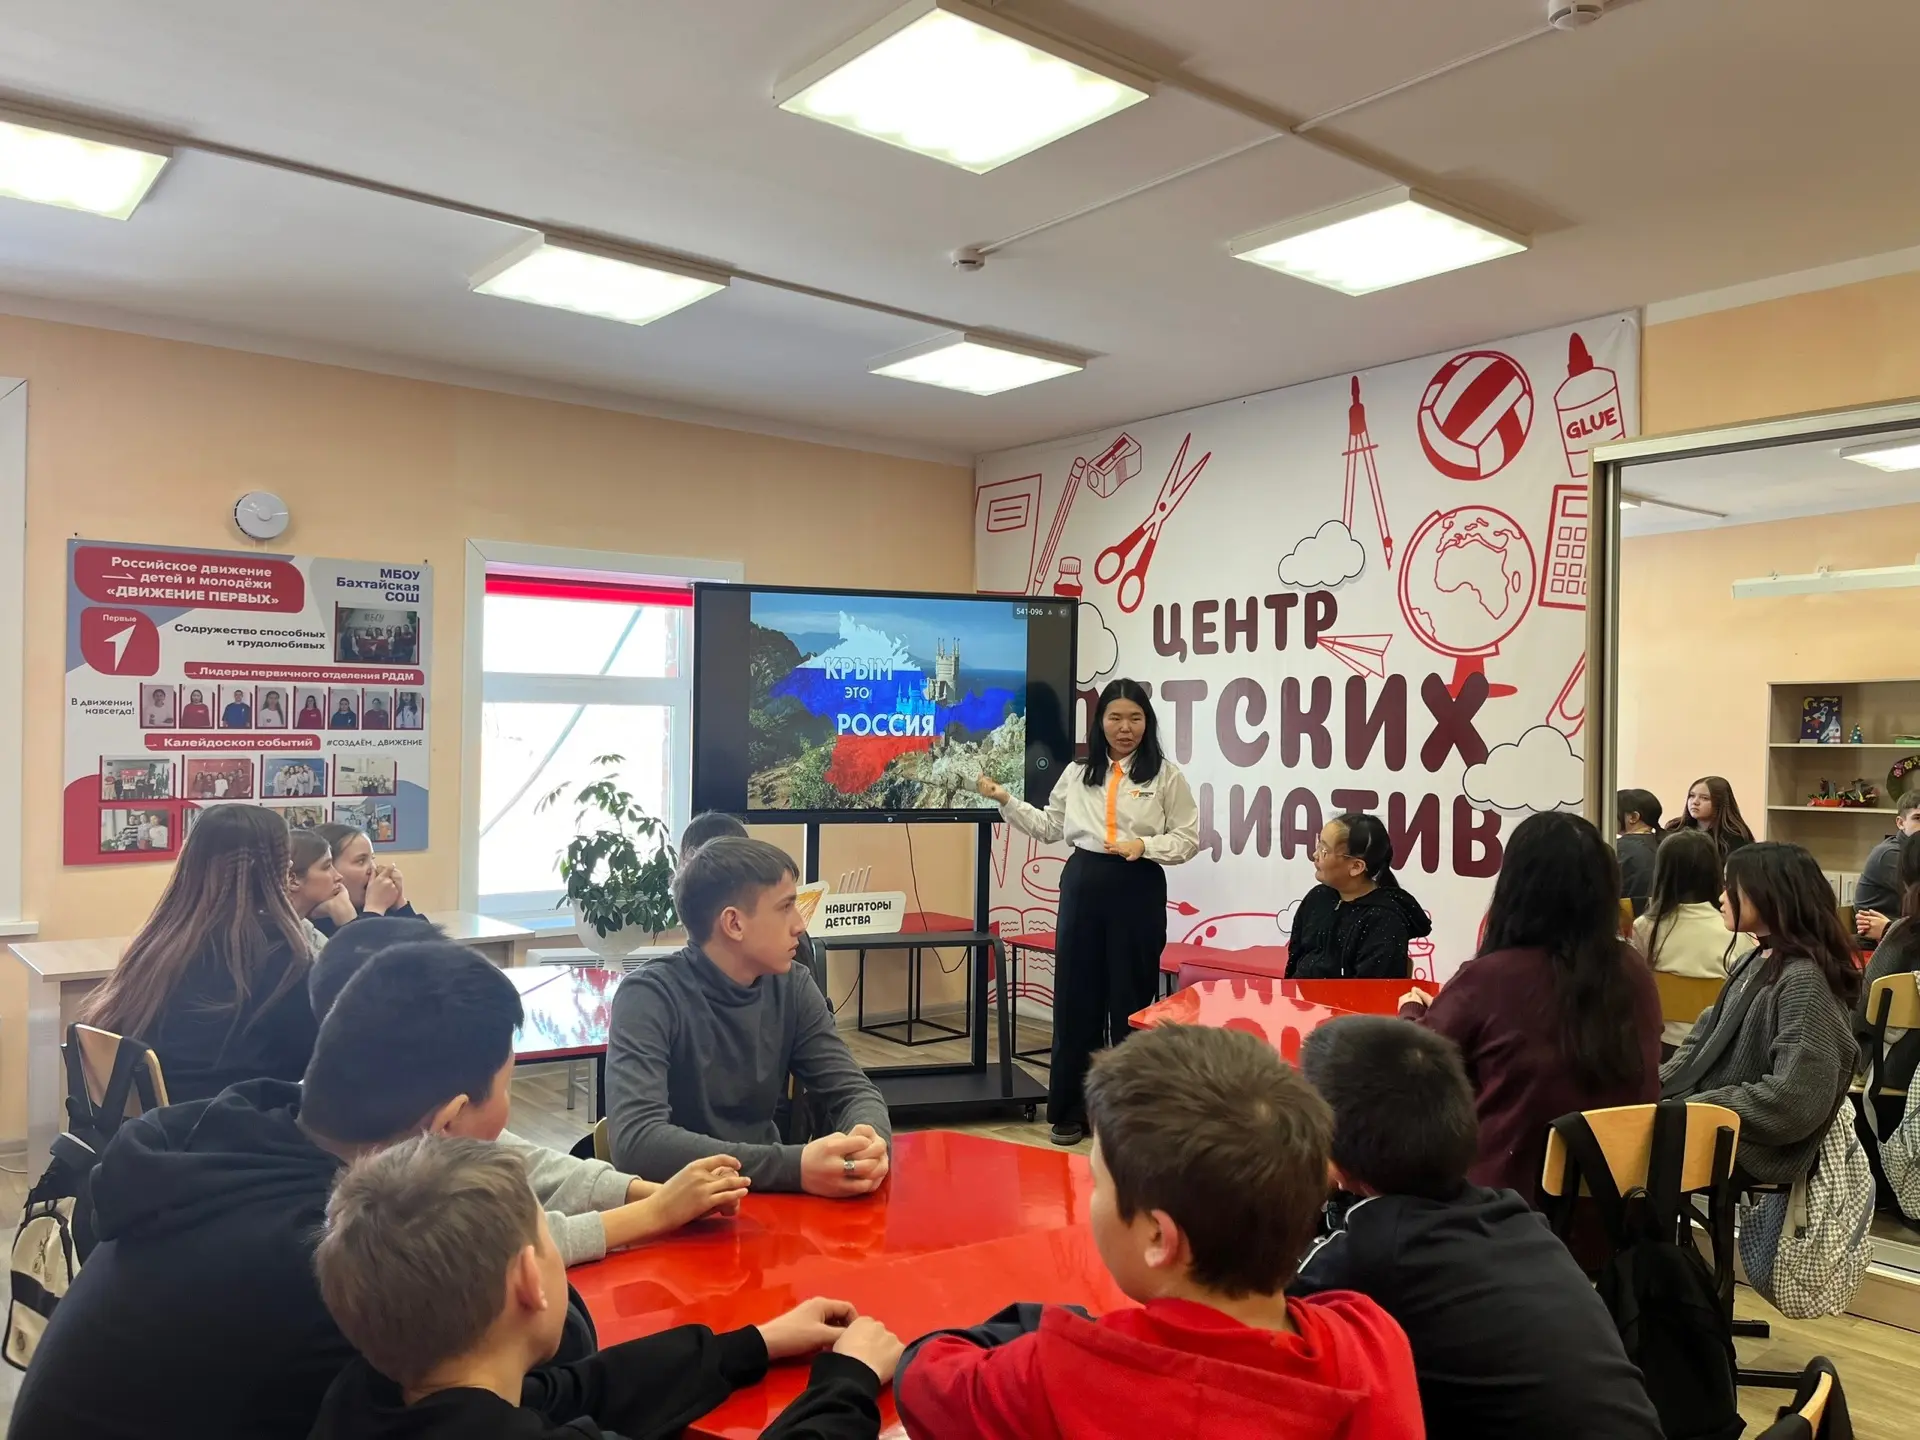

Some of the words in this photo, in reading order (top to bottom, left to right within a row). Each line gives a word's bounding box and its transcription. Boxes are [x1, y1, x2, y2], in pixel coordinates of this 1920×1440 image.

[1566, 407, 1617, 439] GLUE
[111, 556, 198, 572] Российское
[200, 564, 272, 577] движение
[140, 573, 183, 584] детей
[186, 575, 195, 584] и
[199, 576, 272, 589] молодёжи
[380, 568, 420, 580] МБОУ
[336, 576, 420, 592] Бахтайская
[106, 585, 205, 600] «ДВИЖЕНИЕ
[208, 591, 279, 605] ПЕРВЫХ»
[385, 591, 420, 603] СОШ
[102, 614, 137, 622] Первые
[1016, 607, 1044, 616] 541-096
[174, 623, 258, 636] Содружество
[259, 629, 326, 638] способных
[1153, 590, 1338, 663] ЦЕНТР
[236, 639, 325, 650] трудолюбивых
[199, 667, 249, 677] Лидеры
[250, 670, 320, 679] первичного
[322, 671, 381, 680] отделения
[381, 673, 415, 681] РДДМ
[824, 656, 894, 681] КРЫМ
[843, 686, 870, 699] ЭТО
[71, 697, 78, 706] В
[85, 707, 135, 716] навсегда!
[837, 712, 936, 737] РОССИЯ
[163, 738, 255, 747] Калейдоскоп
[256, 738, 313, 747] событий
[825, 900, 892, 914] НАВИГАТОРЫ
[825, 915, 871, 929] ДЕТСТВА
